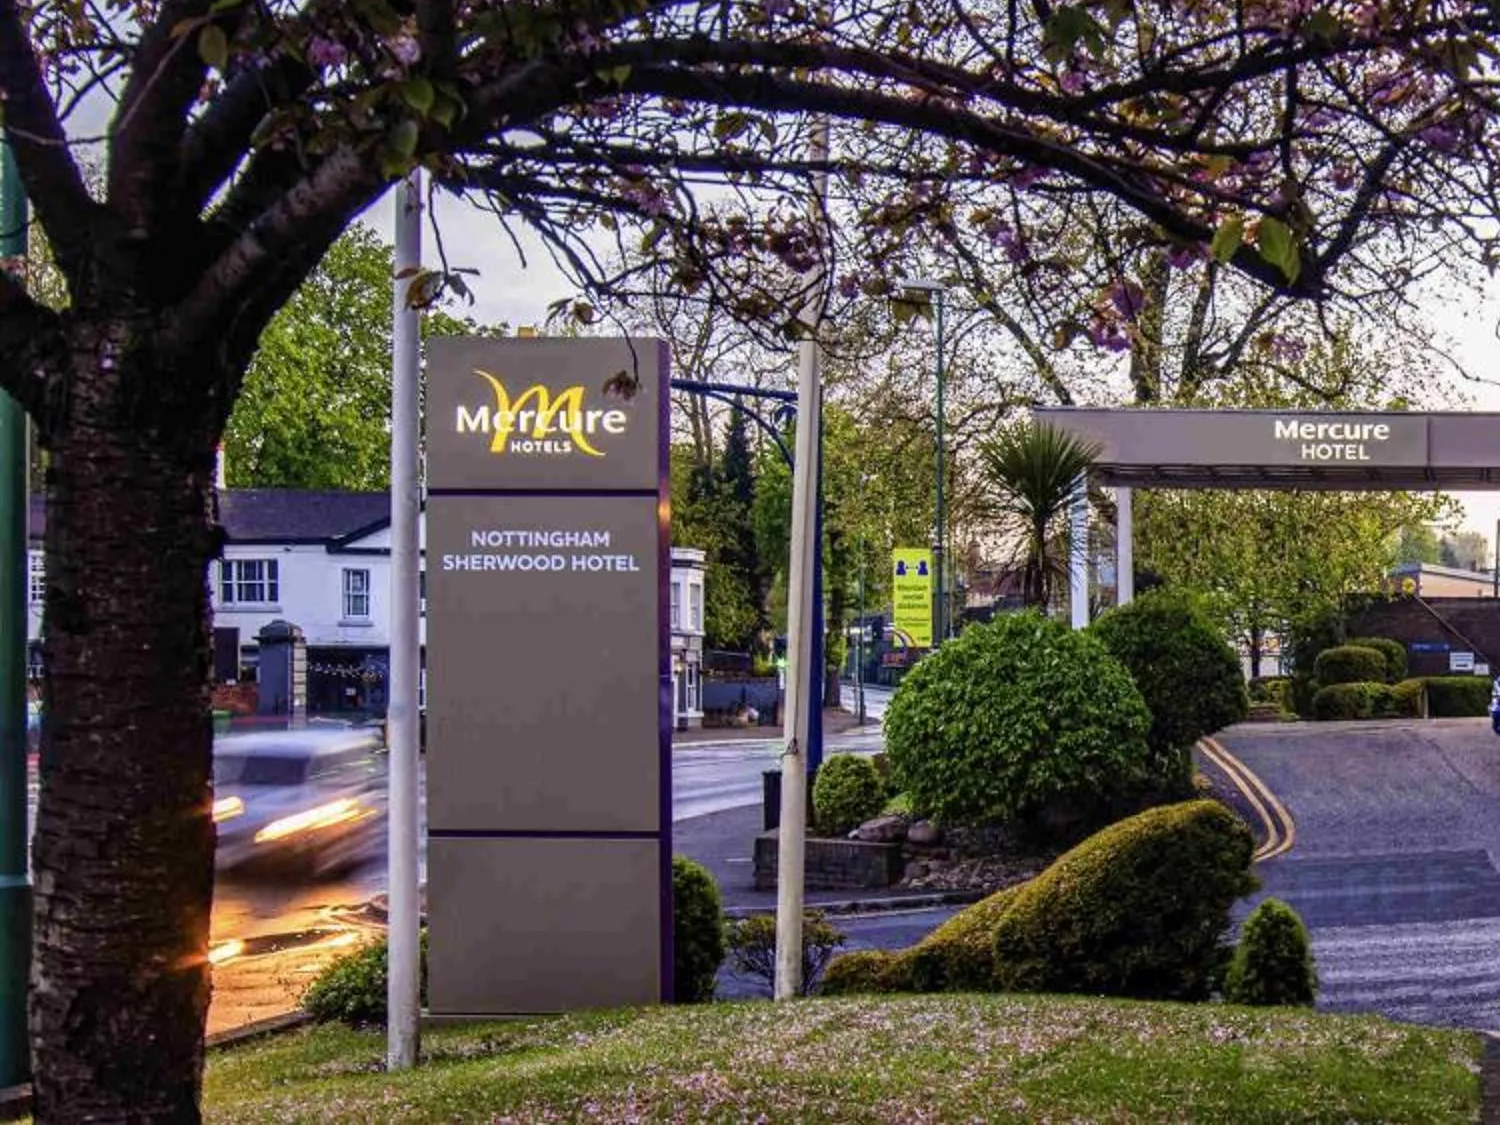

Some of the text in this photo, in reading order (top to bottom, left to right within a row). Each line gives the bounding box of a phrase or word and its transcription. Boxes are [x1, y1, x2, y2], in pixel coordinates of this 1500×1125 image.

[455, 405, 627, 434] Mercure
[1274, 419, 1390, 440] Mercure
[511, 440, 573, 453] HOTELS
[1301, 443, 1371, 460] HOTEL
[471, 530, 611, 548] NOTTINGHAM
[443, 554, 641, 572] SHERWOOD HOTEL
